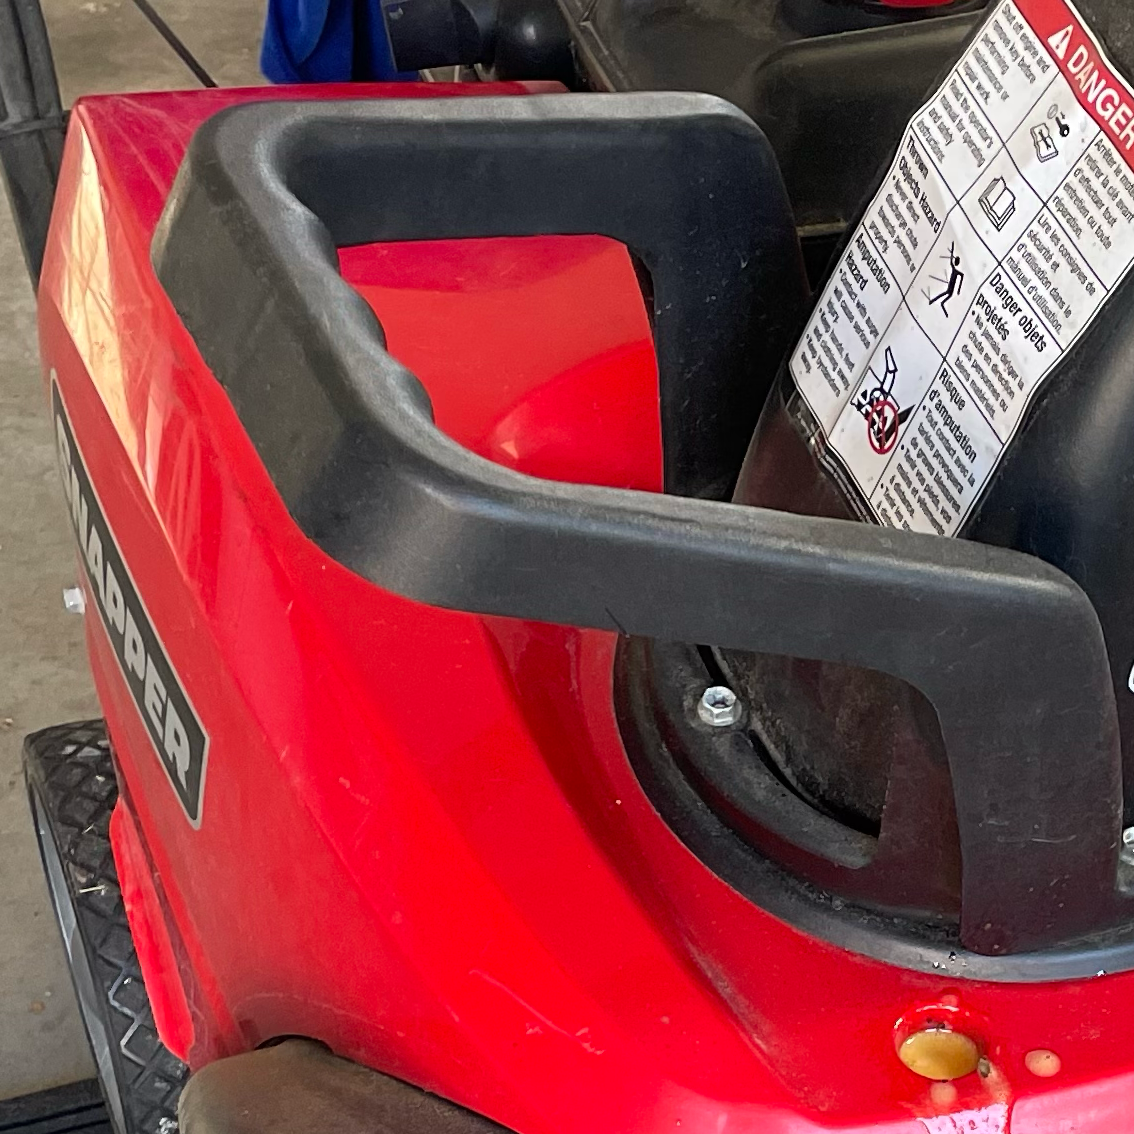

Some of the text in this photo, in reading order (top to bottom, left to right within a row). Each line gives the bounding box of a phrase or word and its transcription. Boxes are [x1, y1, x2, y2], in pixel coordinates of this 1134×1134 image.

[1083, 152, 1105, 181] retirer
[1100, 174, 1110, 190] la
[1106, 184, 1121, 202] clé
[1094, 137, 1117, 169] Arrêter
[898, 155, 943, 235] Objects Hazard
[1062, 180, 1112, 251] entretien ou toute
[1102, 205, 1118, 229] tout
[844, 249, 869, 292] Hazard
[854, 232, 891, 295] Amputation
[1026, 228, 1061, 274] sécurité et
[1037, 212, 1096, 297] Lire les consignes de
[1016, 242, 1072, 319] d'utilisation dans le
[975, 291, 1010, 342] projetés
[988, 271, 1047, 354] Danger objets
[1026, 284, 1063, 336] d'utilisation.
[983, 352, 992, 367] en
[938, 367, 966, 412] Risque
[999, 398, 1009, 413] ou
[925, 407, 939, 432] Tout
[935, 427, 957, 460] contact
[953, 455, 969, 479] avec
[928, 388, 977, 464] d'amputation
